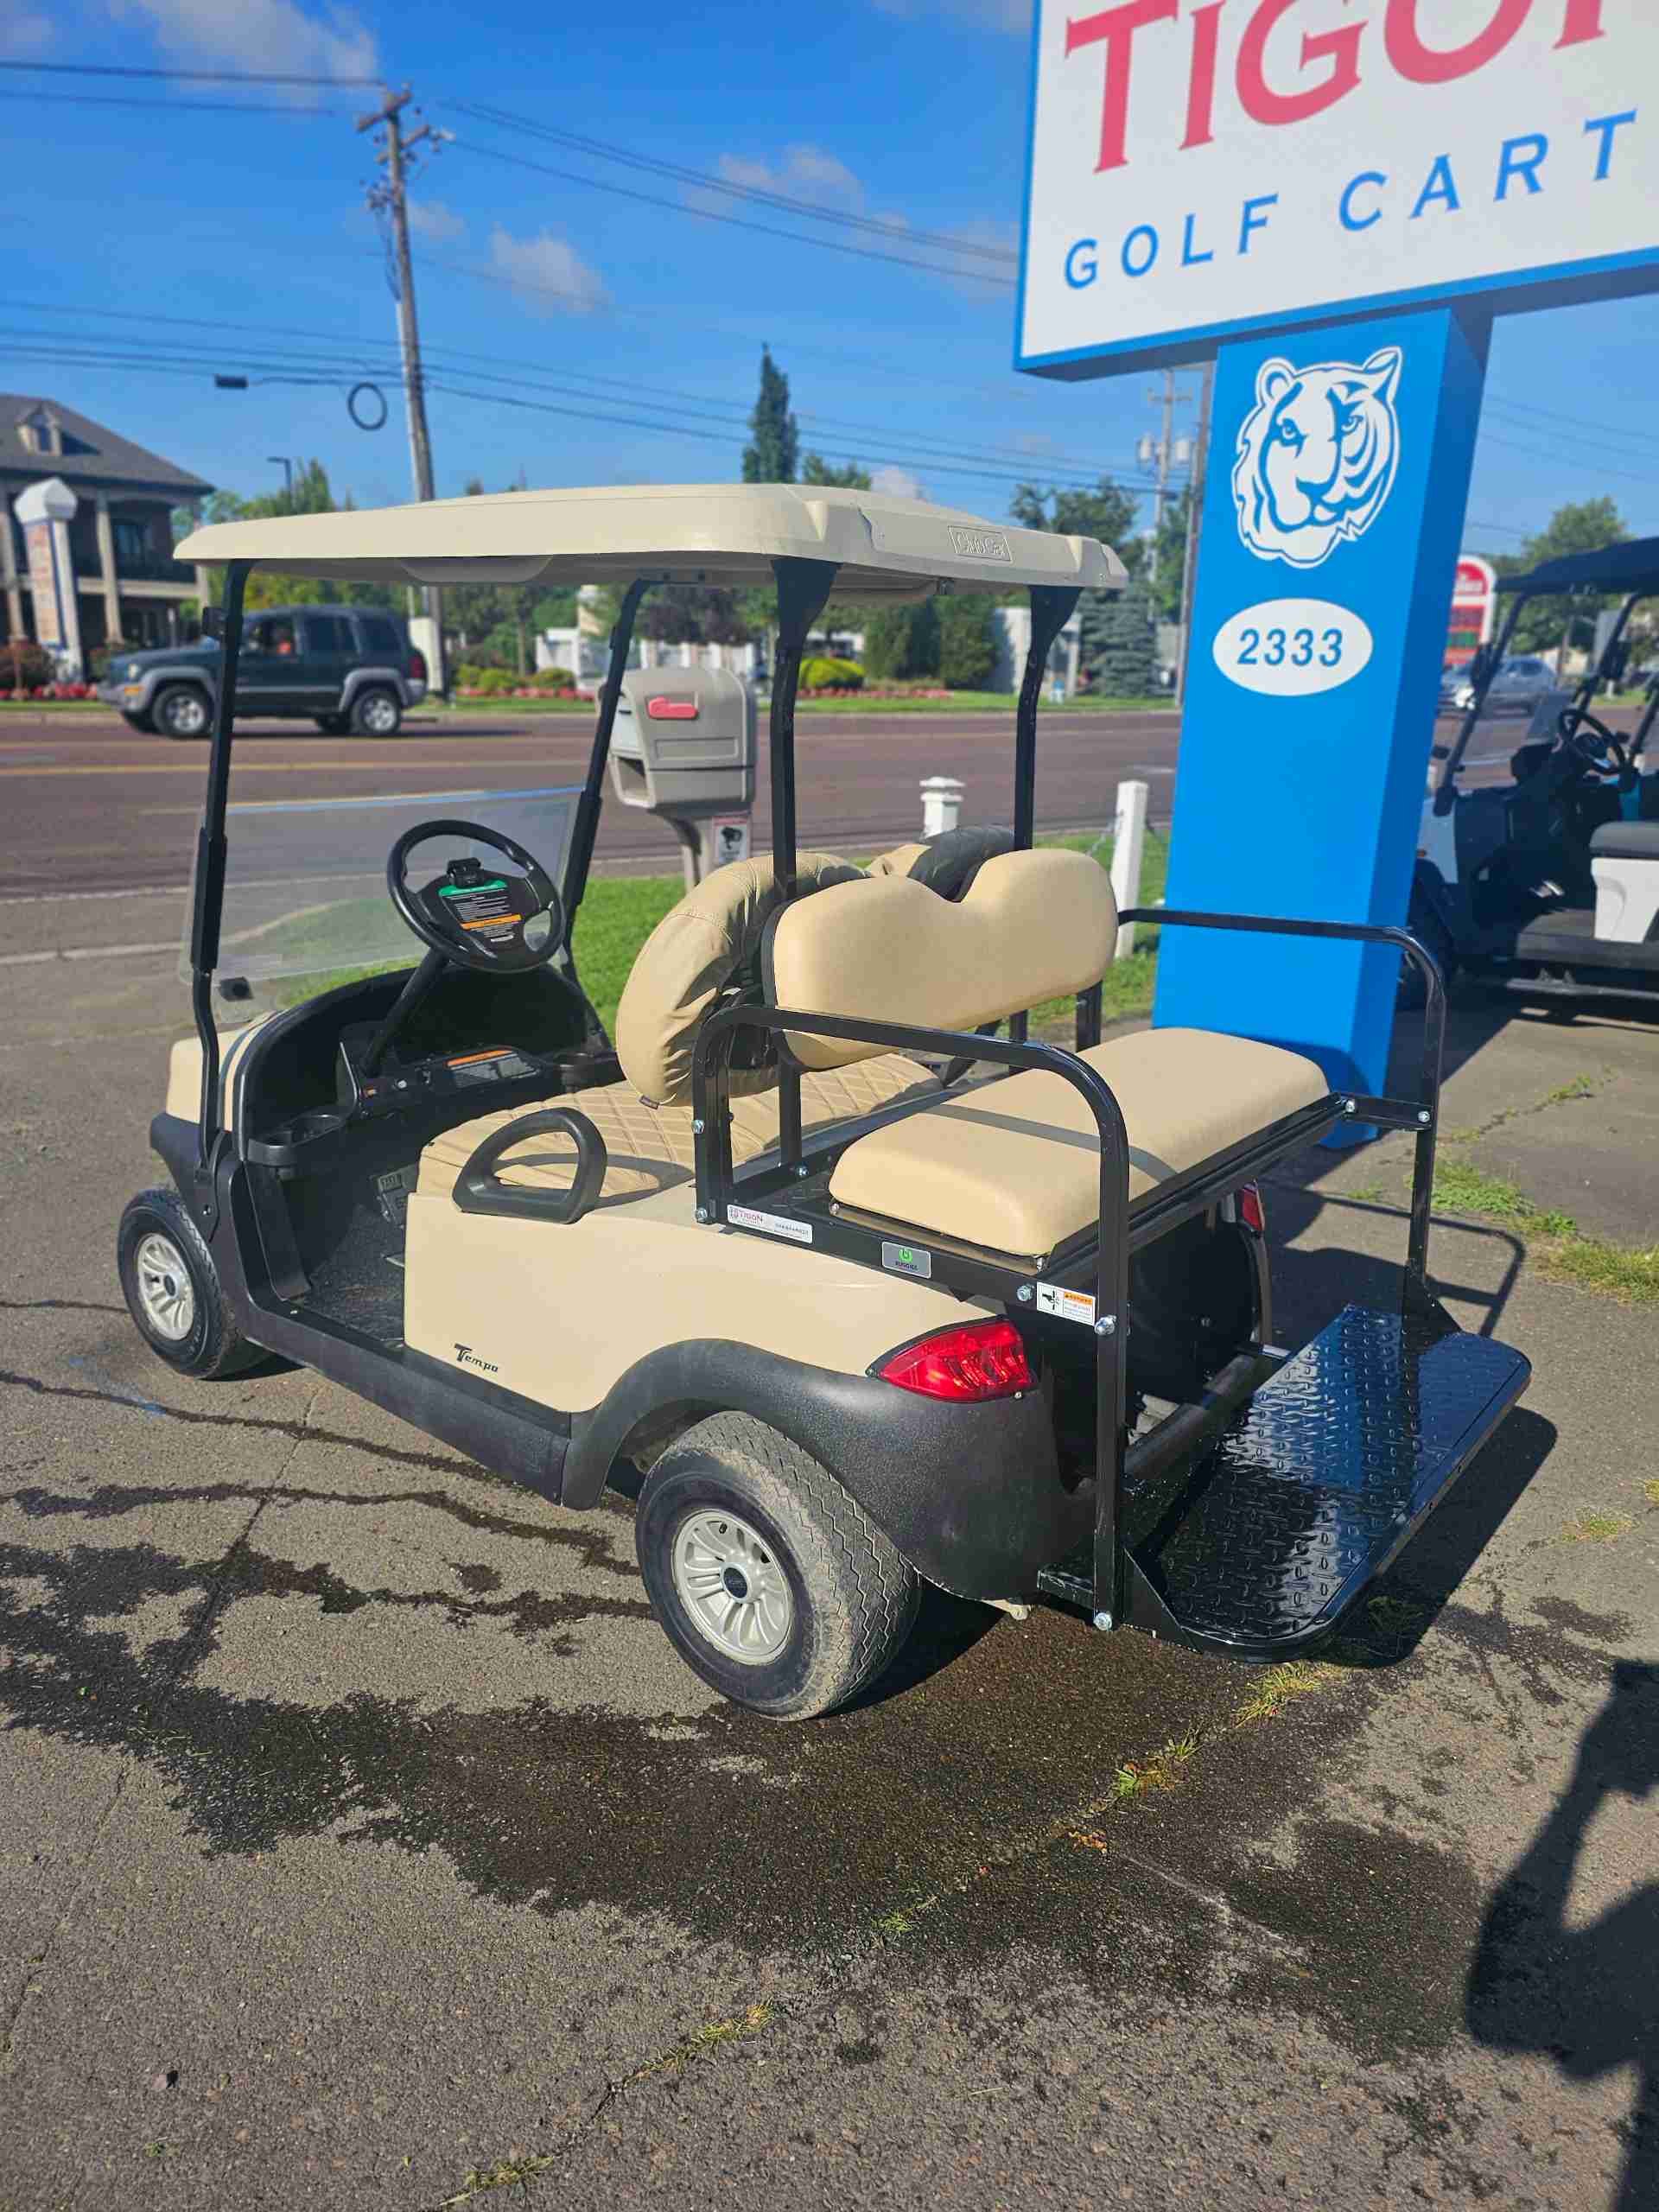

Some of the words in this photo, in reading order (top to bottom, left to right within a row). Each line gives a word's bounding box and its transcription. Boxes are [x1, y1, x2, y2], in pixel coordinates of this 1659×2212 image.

[1065, 0, 1605, 174] TIGO
[1064, 192, 1279, 289] GOLF
[1338, 108, 1638, 232] CART
[1236, 627, 1344, 667] 2333
[453, 1342, 499, 1373] Tempo
